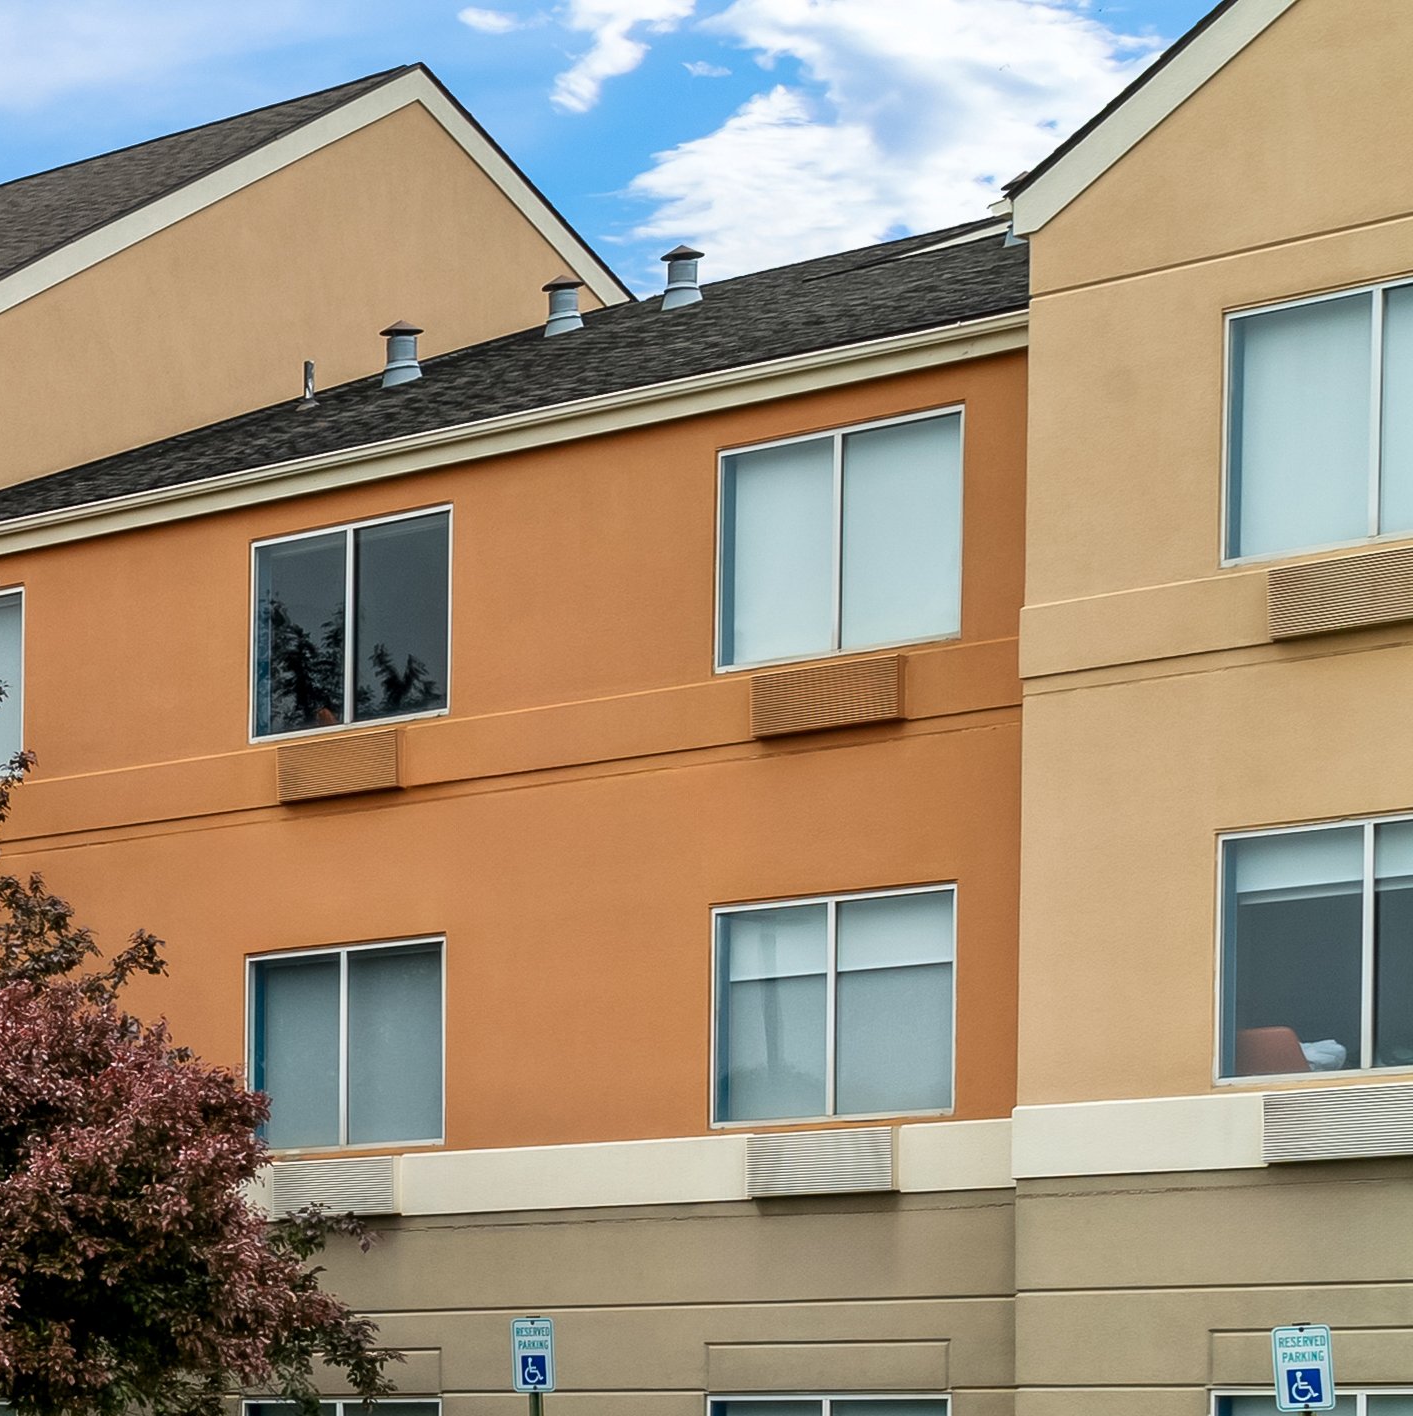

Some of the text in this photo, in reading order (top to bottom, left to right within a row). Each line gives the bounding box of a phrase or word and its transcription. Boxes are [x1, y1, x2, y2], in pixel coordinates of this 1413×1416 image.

[516, 1326, 550, 1337] RESERVED
[518, 1340, 549, 1350] PARKING
[1278, 1335, 1326, 1348] RESERVED
[1282, 1350, 1325, 1363] PARKING
